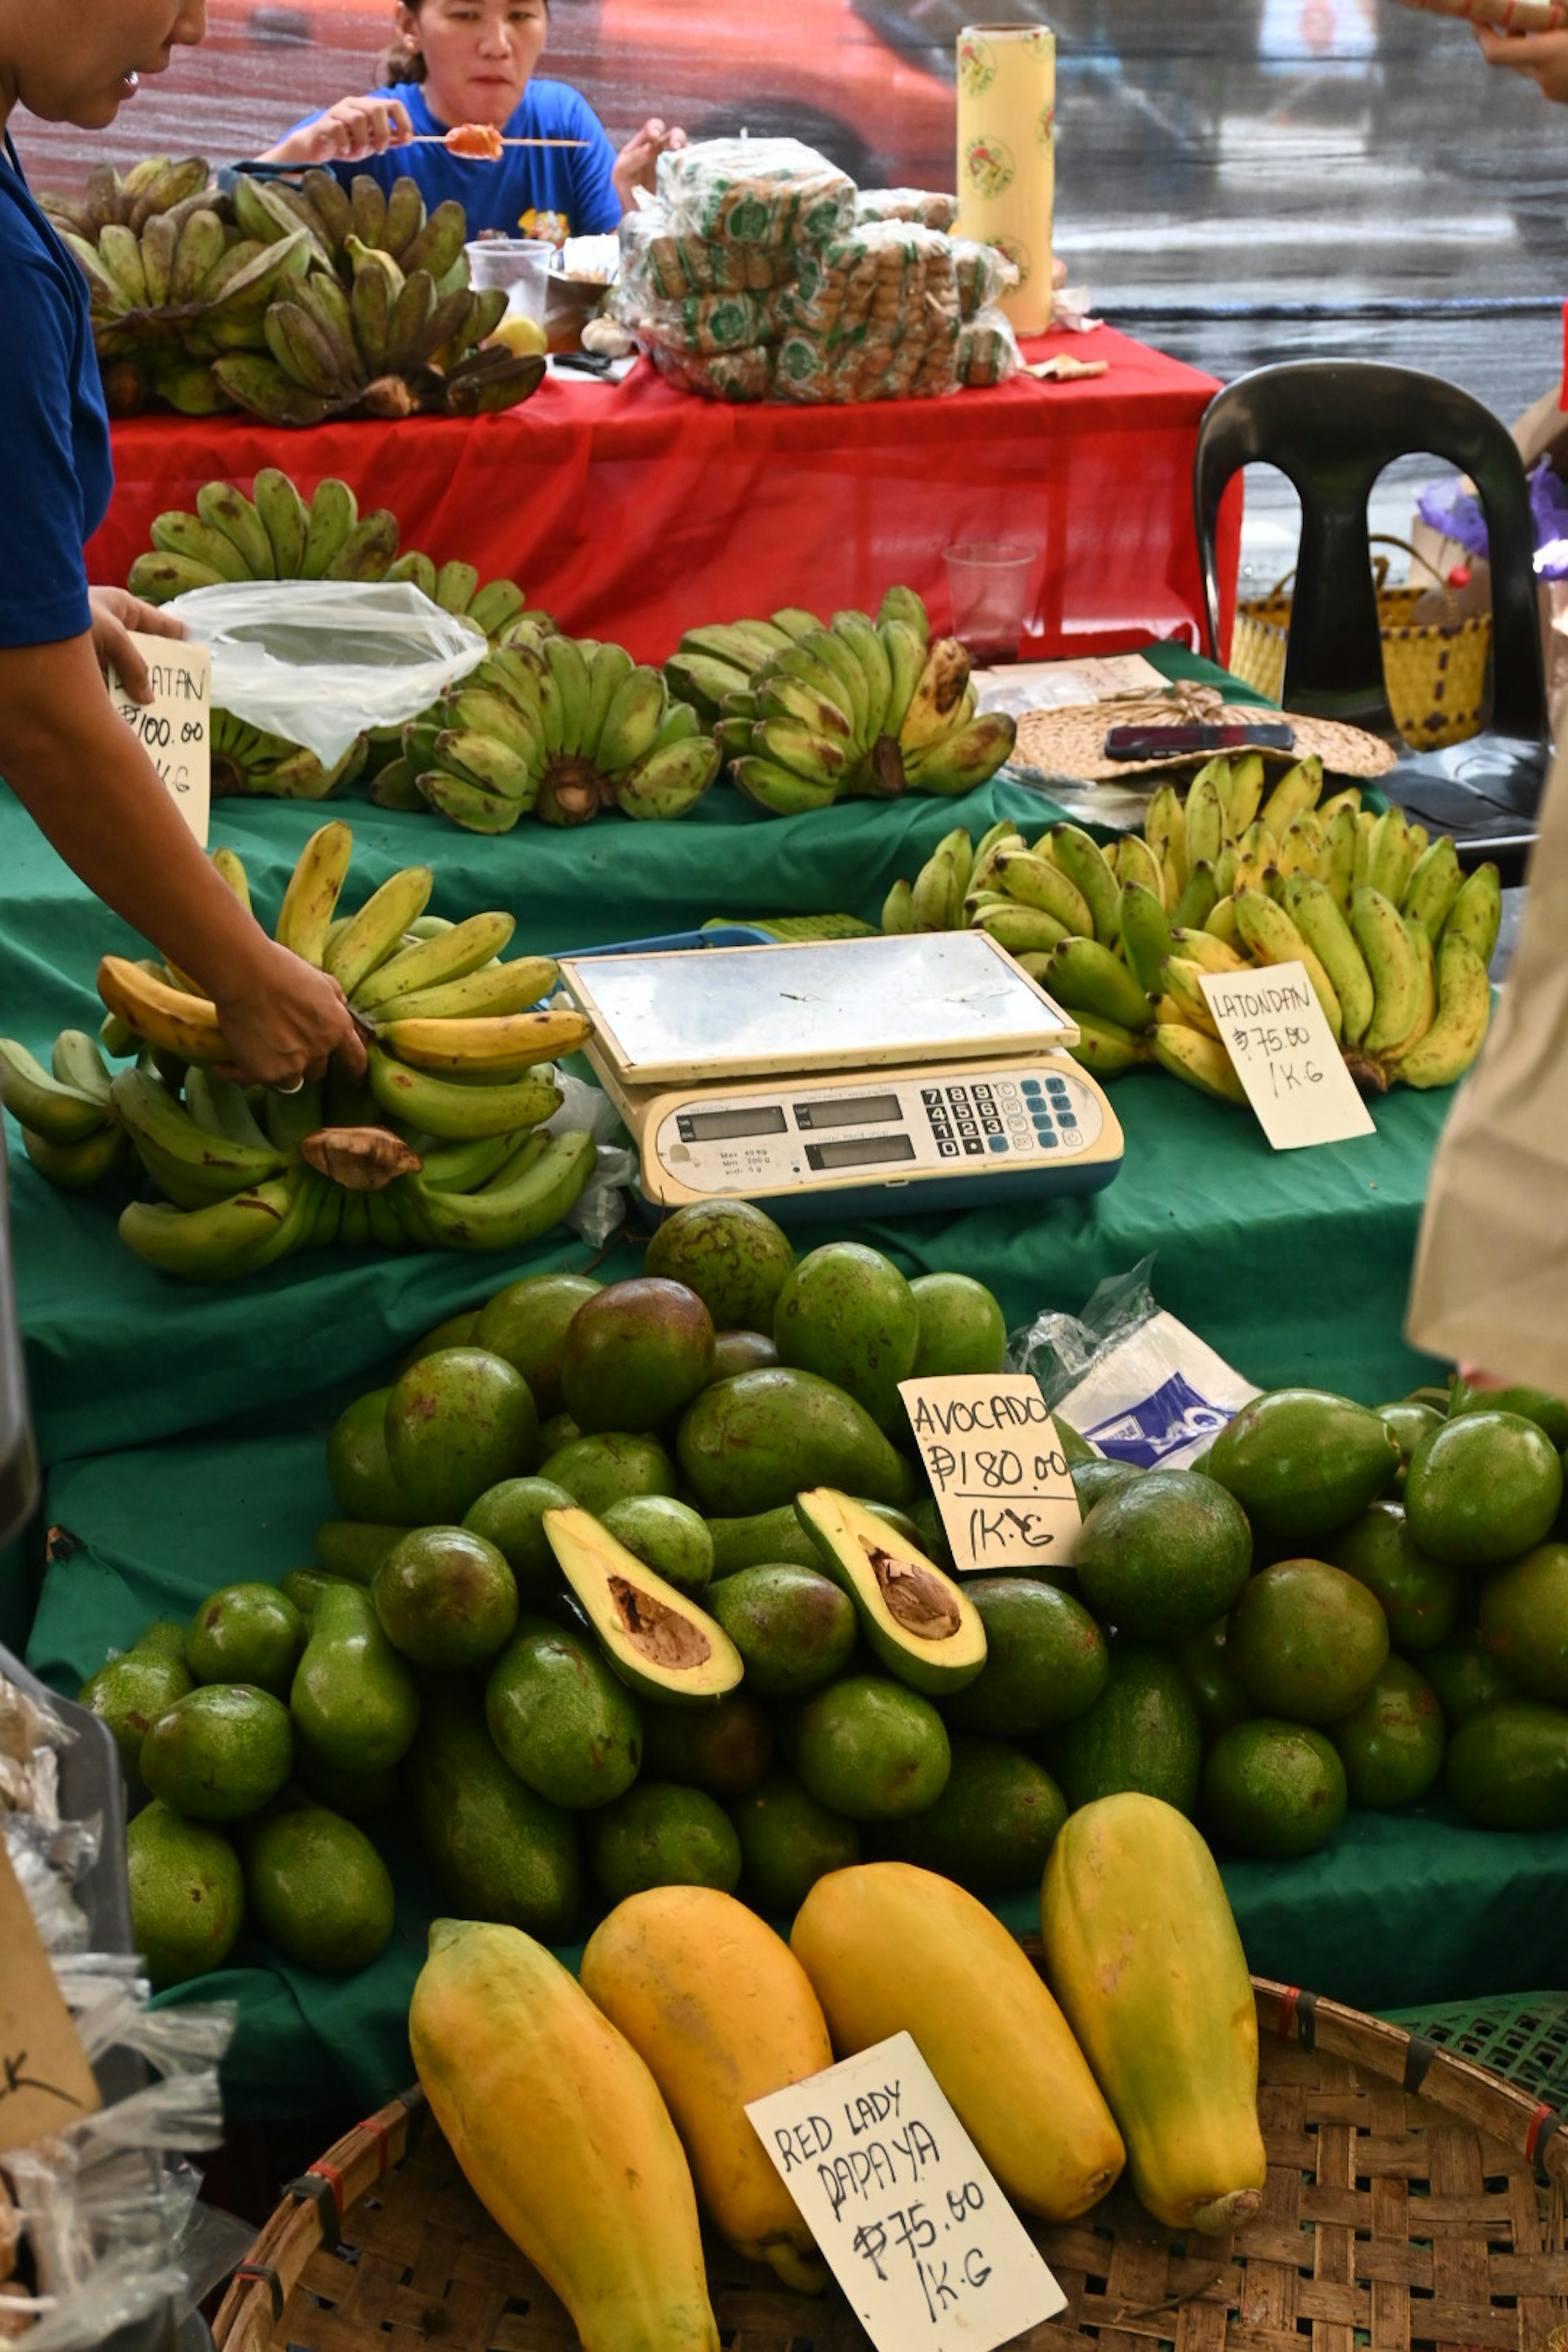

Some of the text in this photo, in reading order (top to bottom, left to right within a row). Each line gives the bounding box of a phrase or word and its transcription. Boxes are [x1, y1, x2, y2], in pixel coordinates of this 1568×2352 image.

[1212, 982, 1310, 1018] LATONDAN
[926, 1091, 938, 1104] 7
[950, 1088, 964, 1101] 8
[975, 1085, 989, 1098] 9
[1002, 1084, 1012, 1097] C
[931, 1107, 946, 1120] 4
[956, 1105, 970, 1118] 5
[981, 1102, 995, 1116] 6
[938, 1125, 949, 1138] 1
[962, 1122, 976, 1136] 2
[986, 1120, 1000, 1133] 3
[942, 1142, 956, 1155] 0
[913, 1396, 1049, 1434] AVOCADO
[774, 2080, 901, 2173] RED LADY
